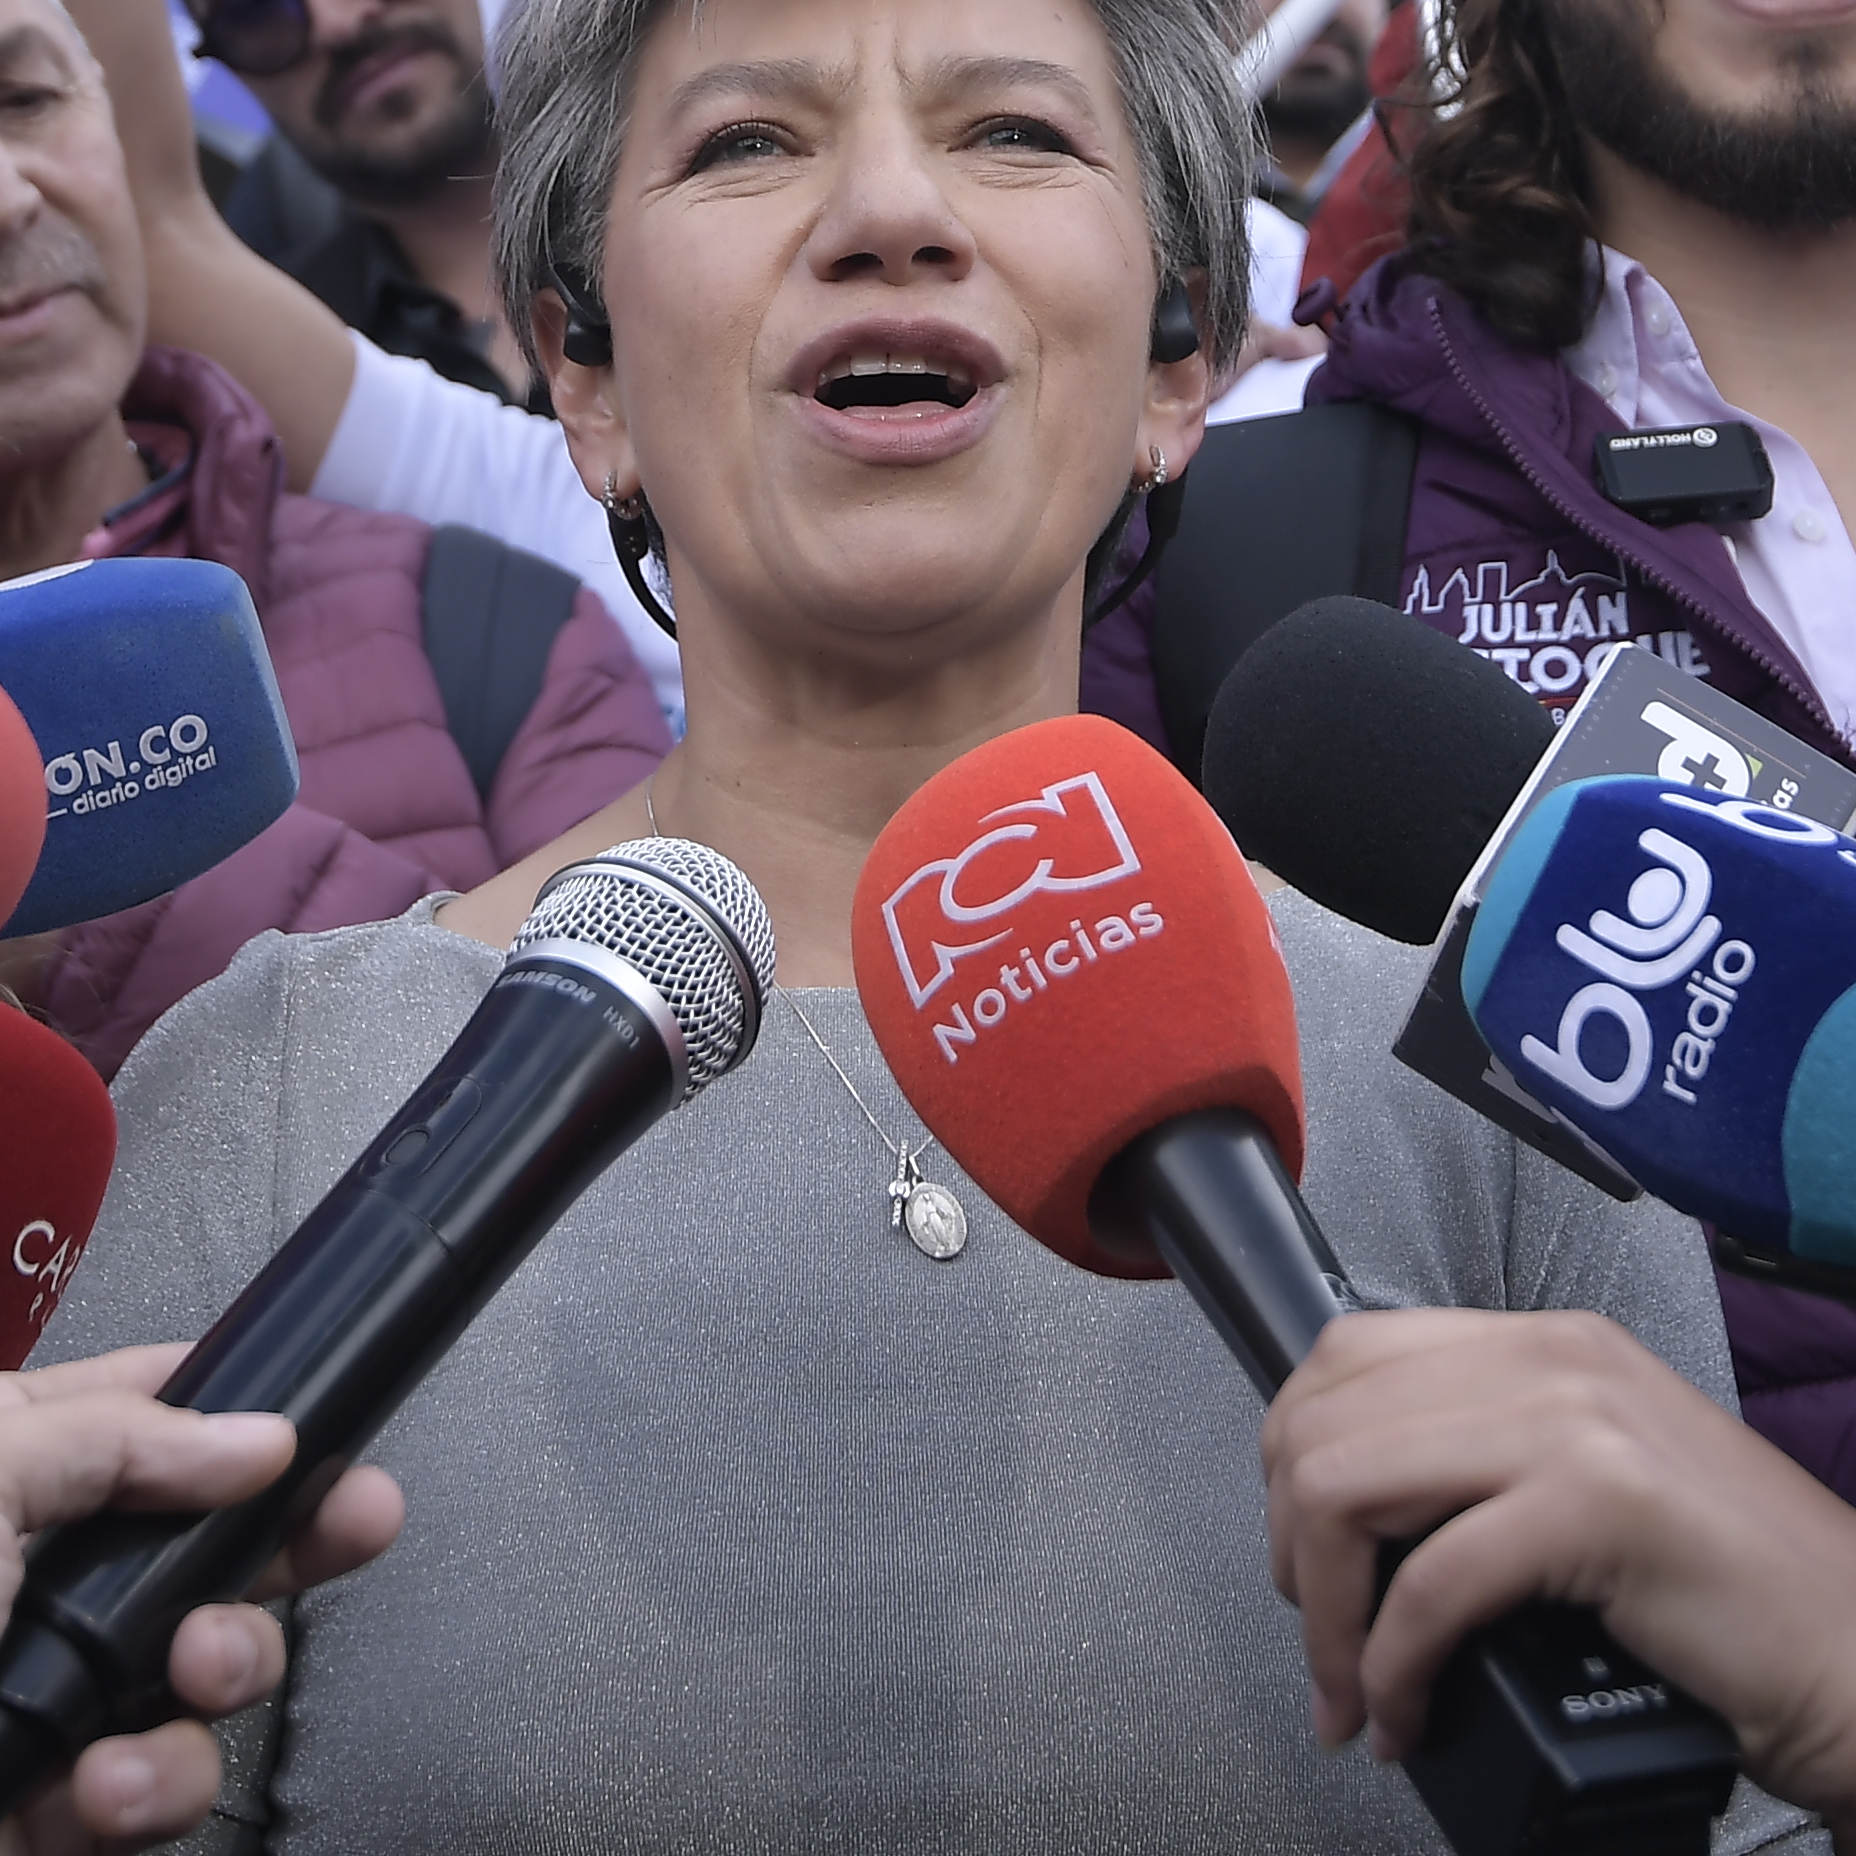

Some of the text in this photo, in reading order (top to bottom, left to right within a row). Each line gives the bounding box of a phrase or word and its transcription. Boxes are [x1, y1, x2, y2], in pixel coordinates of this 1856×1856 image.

[1457, 586, 1629, 645] JULIÁN
[72, 745, 218, 815] diario digital
[932, 901, 1165, 1064] Noticias
[1520, 827, 1724, 1112] blu
[1661, 938, 1758, 1105] radio
[1561, 1682, 1667, 1720] SONY
